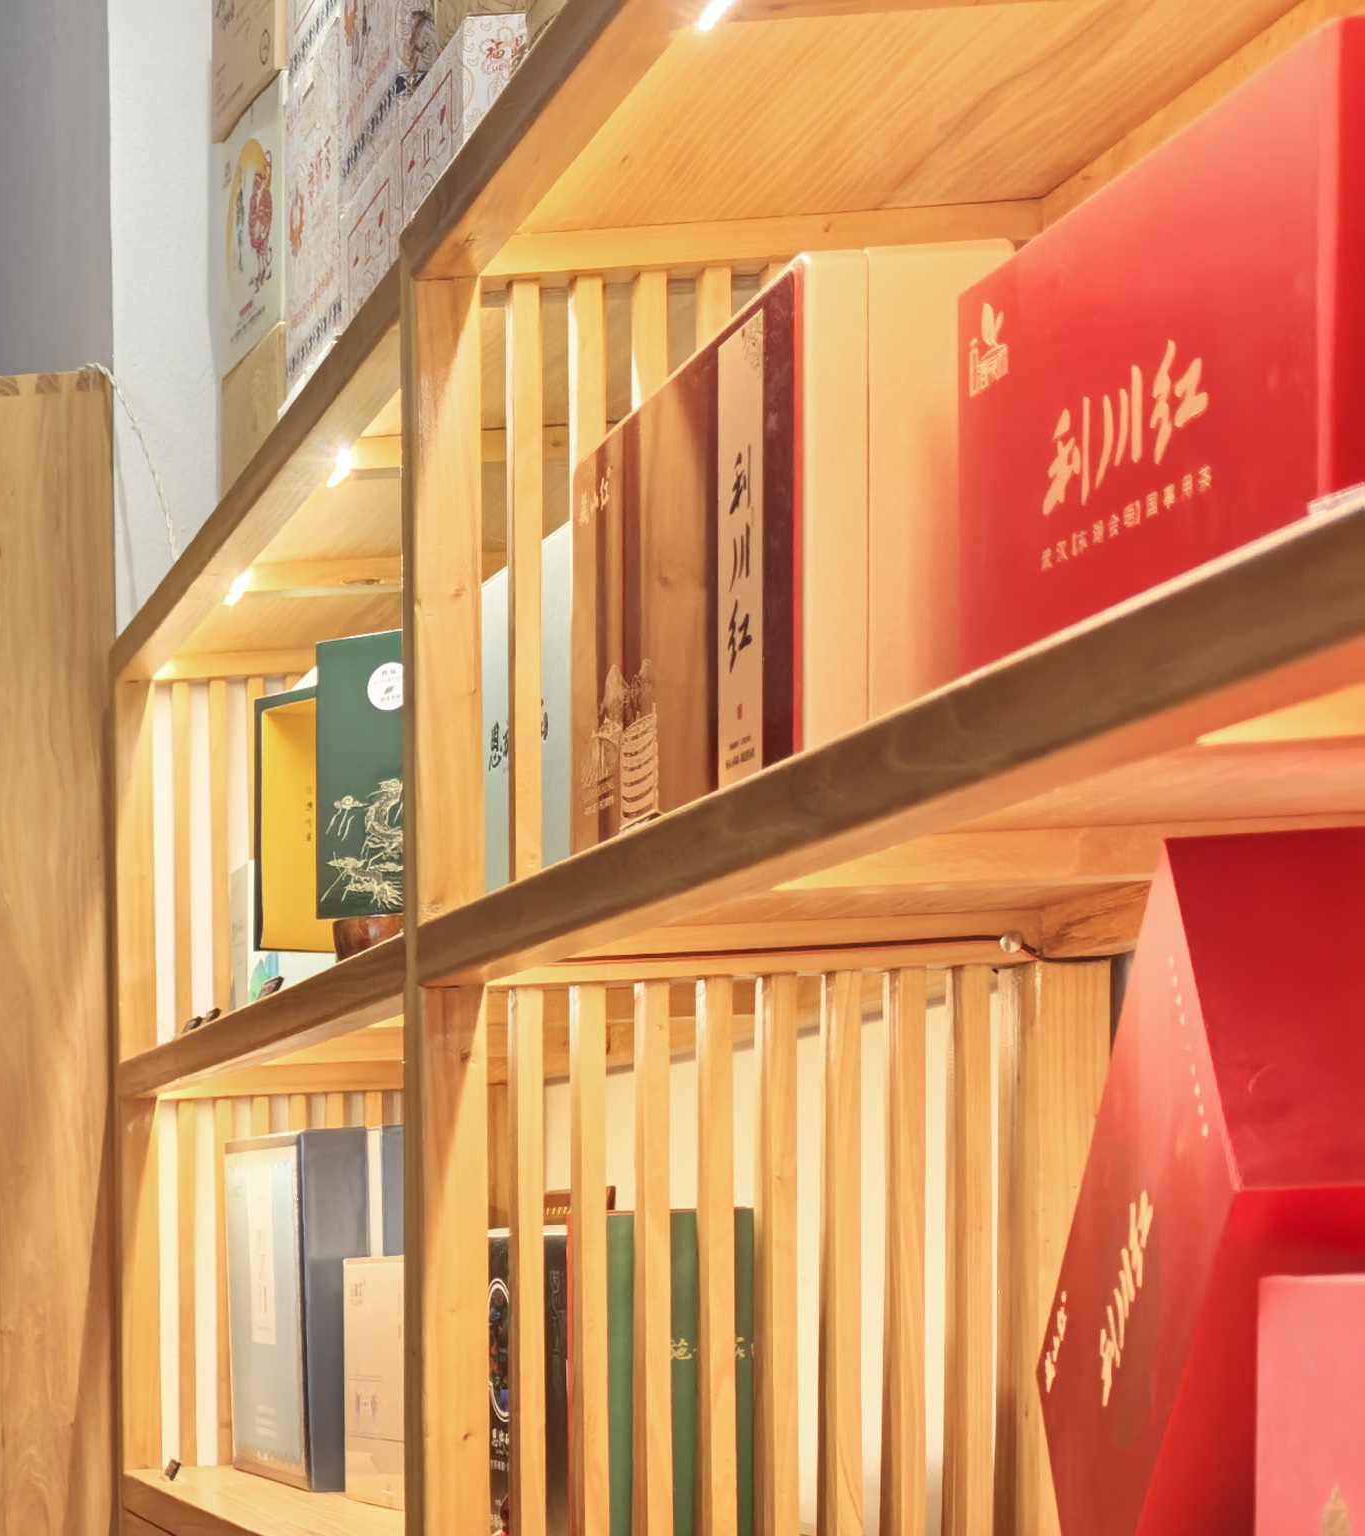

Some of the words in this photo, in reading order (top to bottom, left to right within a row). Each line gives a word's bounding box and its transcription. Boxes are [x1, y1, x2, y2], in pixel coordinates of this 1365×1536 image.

[1043, 339, 1209, 516] 利川红
[725, 445, 754, 674] 利川红
